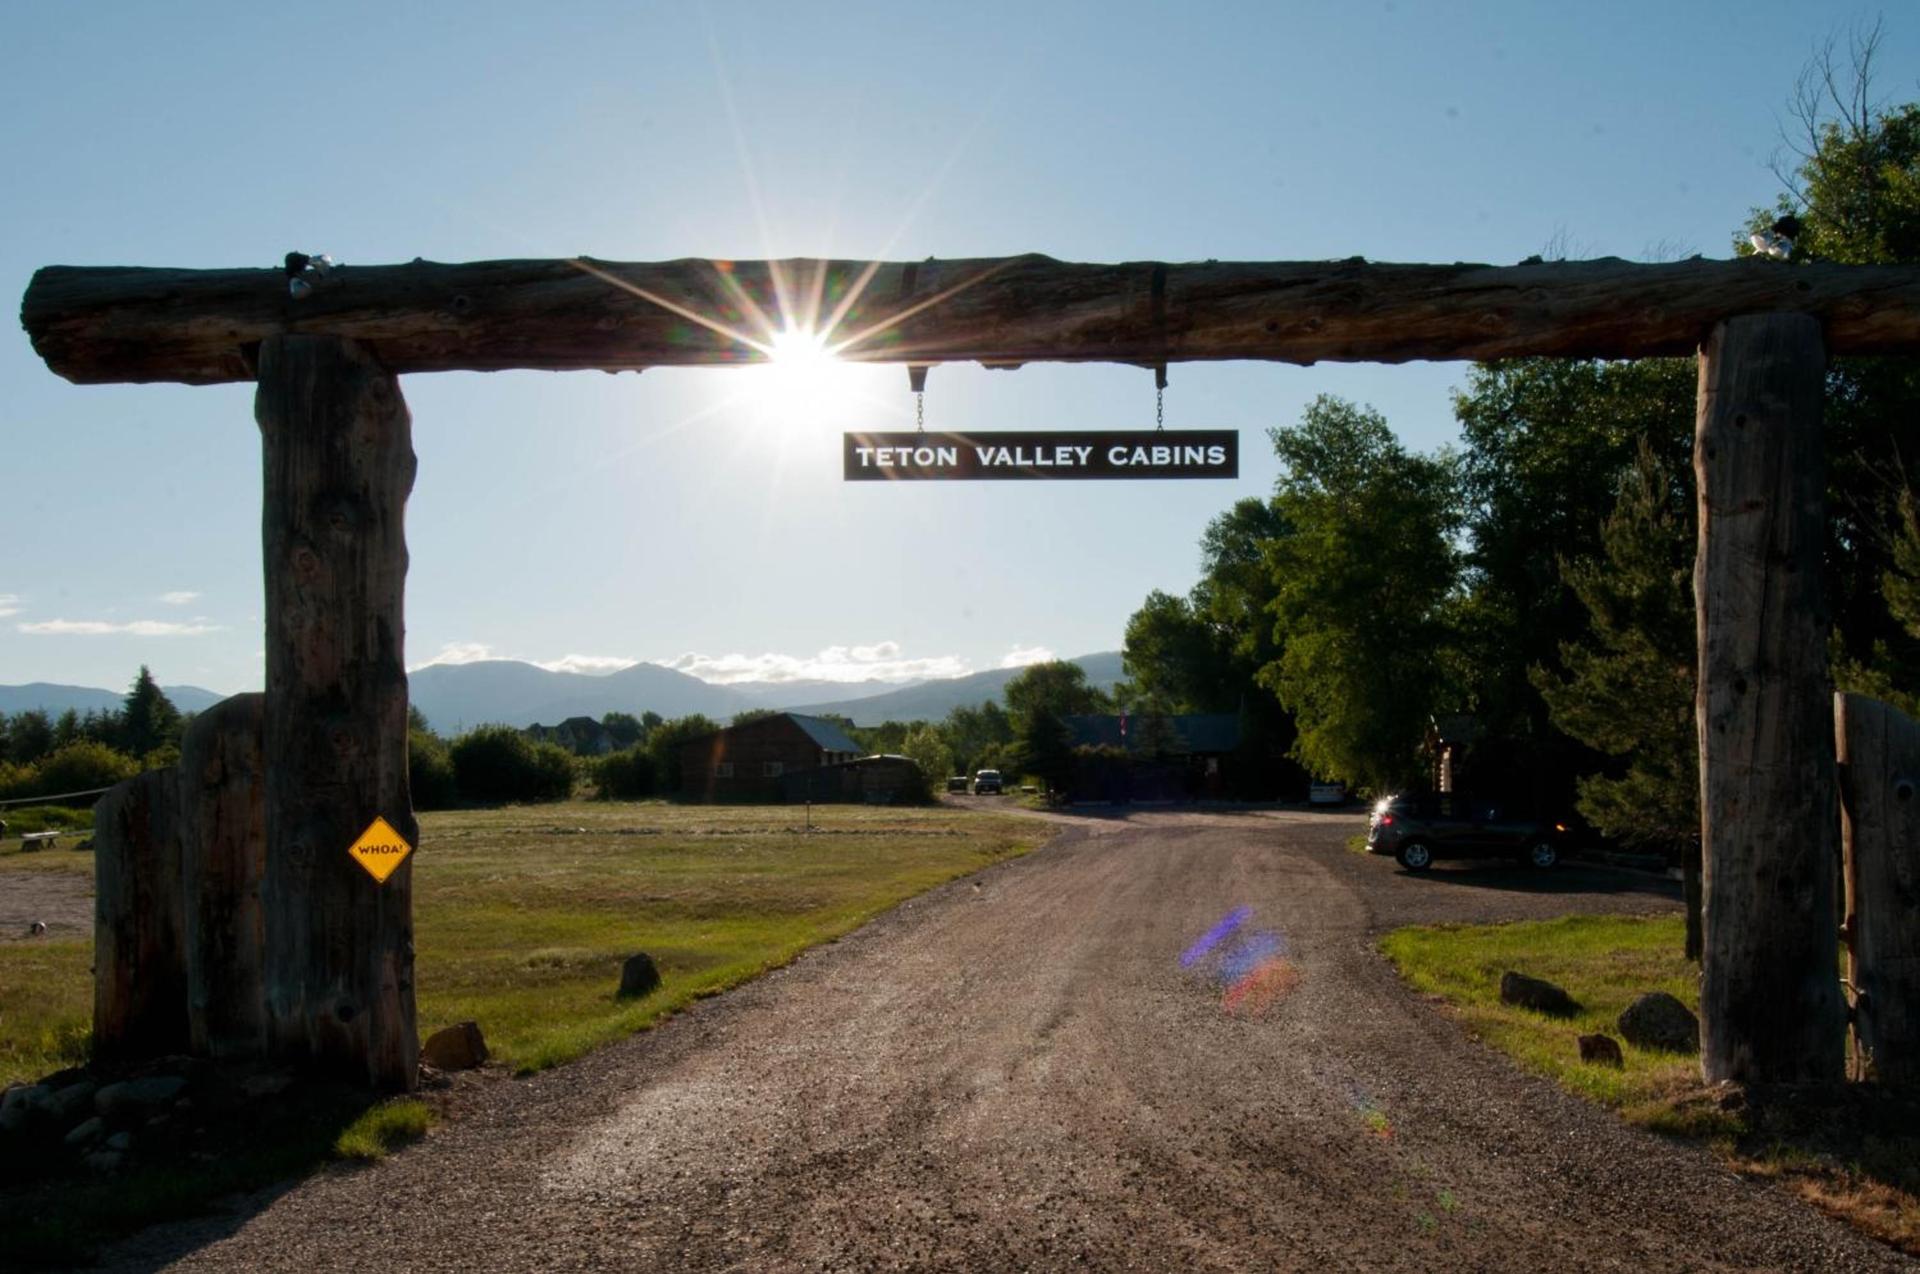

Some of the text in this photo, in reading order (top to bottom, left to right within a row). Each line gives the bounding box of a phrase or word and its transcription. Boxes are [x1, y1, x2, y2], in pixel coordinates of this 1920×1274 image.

[855, 446, 1227, 467] TETON VALLEY CABINS
[357, 843, 404, 855] WHOA!
